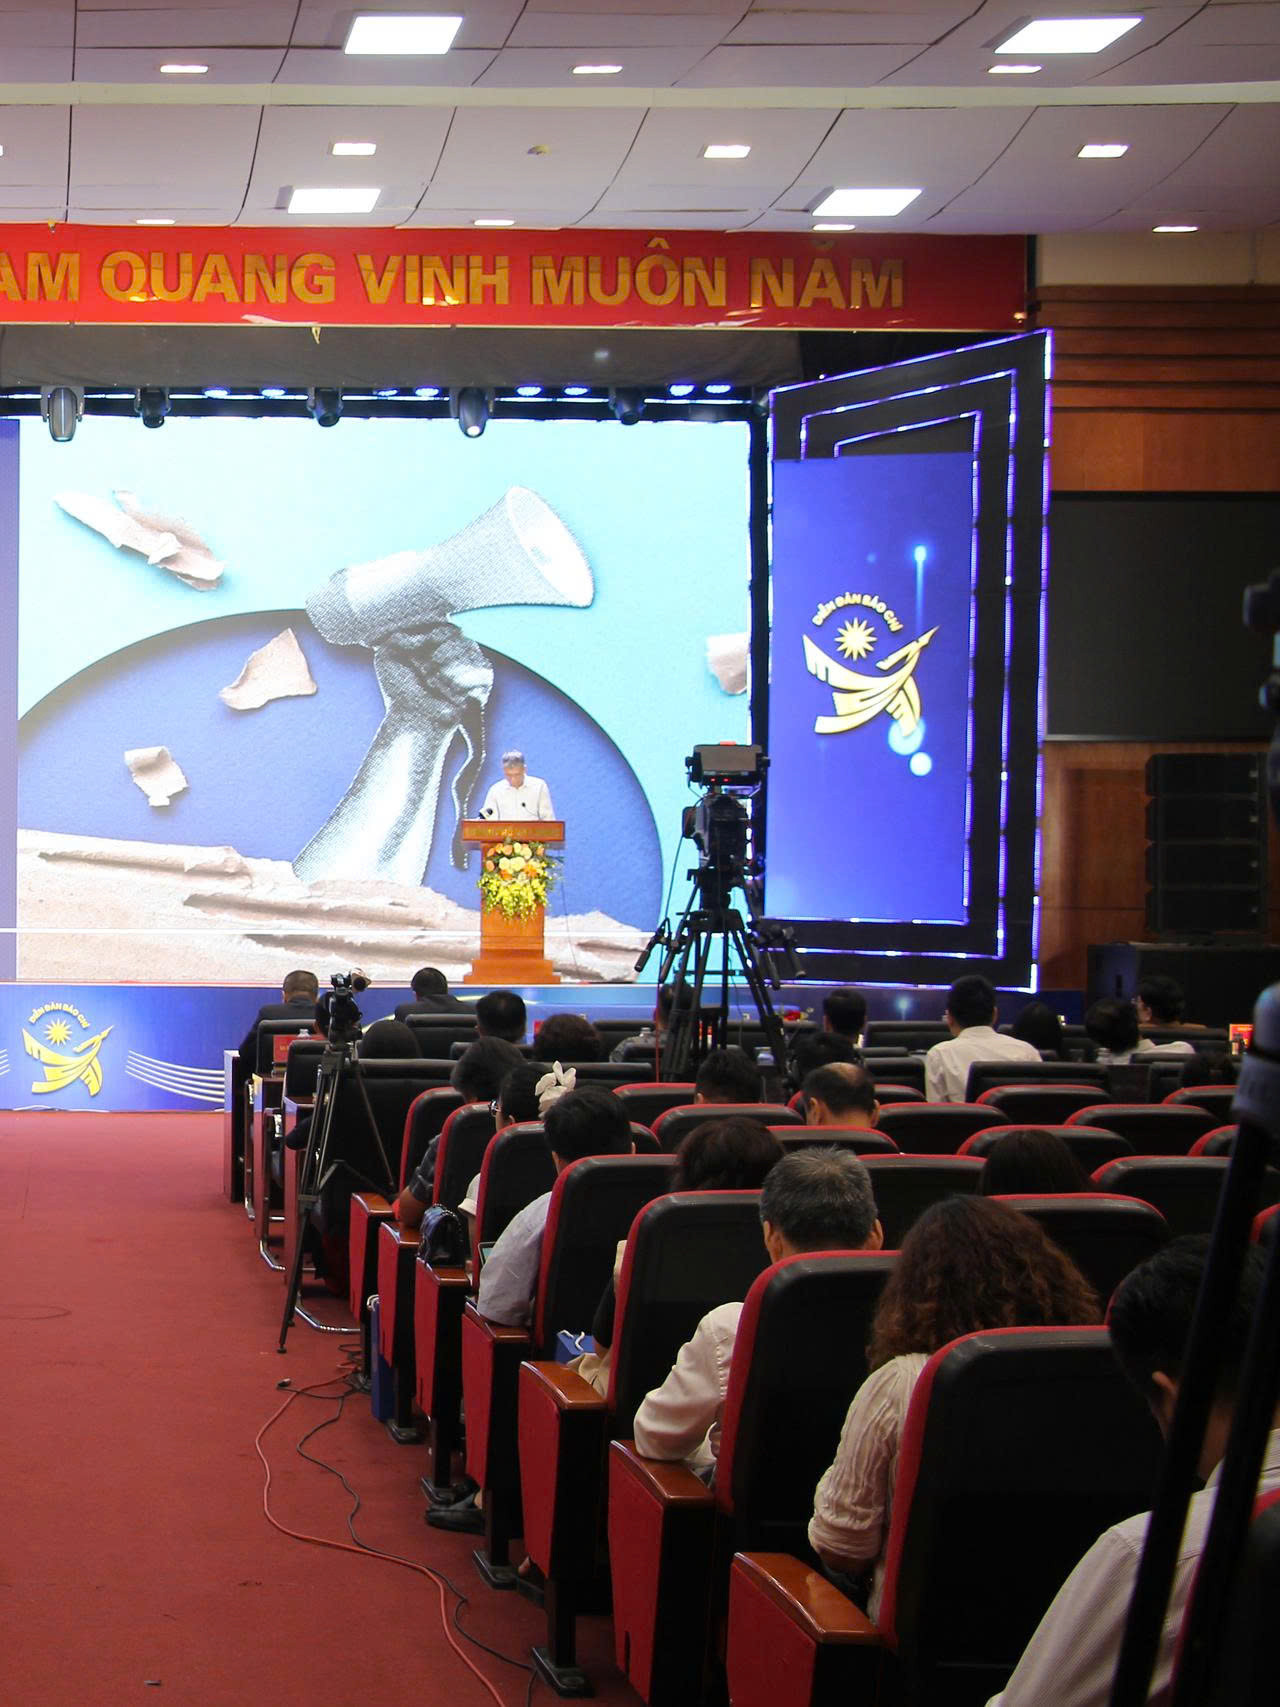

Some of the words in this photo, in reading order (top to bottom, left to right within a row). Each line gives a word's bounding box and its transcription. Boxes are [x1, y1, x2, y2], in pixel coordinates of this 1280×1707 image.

[101, 250, 336, 304] QUANG
[356, 254, 511, 306] VINH
[530, 237, 727, 307] MUÔN
[750, 238, 904, 309] NĂM
